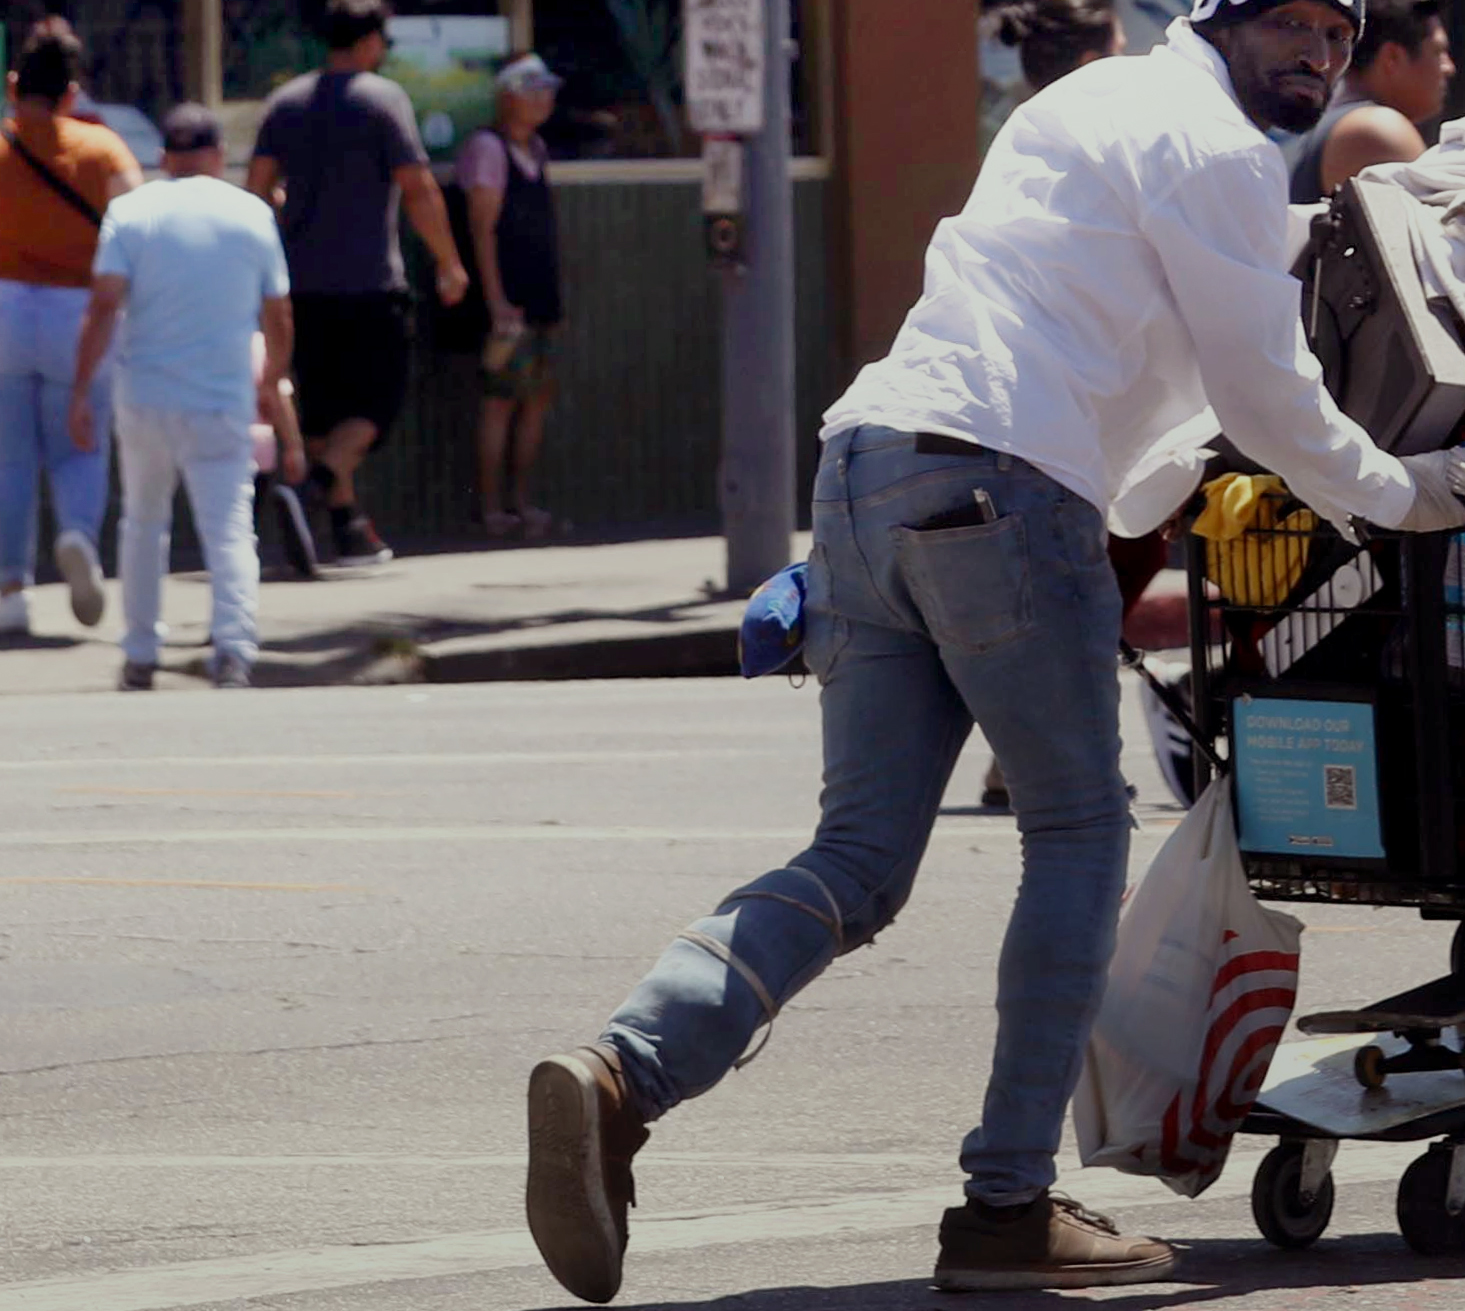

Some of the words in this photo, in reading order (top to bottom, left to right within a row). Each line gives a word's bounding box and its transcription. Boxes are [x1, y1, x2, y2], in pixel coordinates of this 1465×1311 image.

[1246, 715, 1321, 732] DOWNLOAD
[1323, 718, 1350, 733] OUR
[1246, 735, 1295, 750] MOBILE
[1298, 738, 1321, 750] APP
[1324, 739, 1365, 753] TODAY
